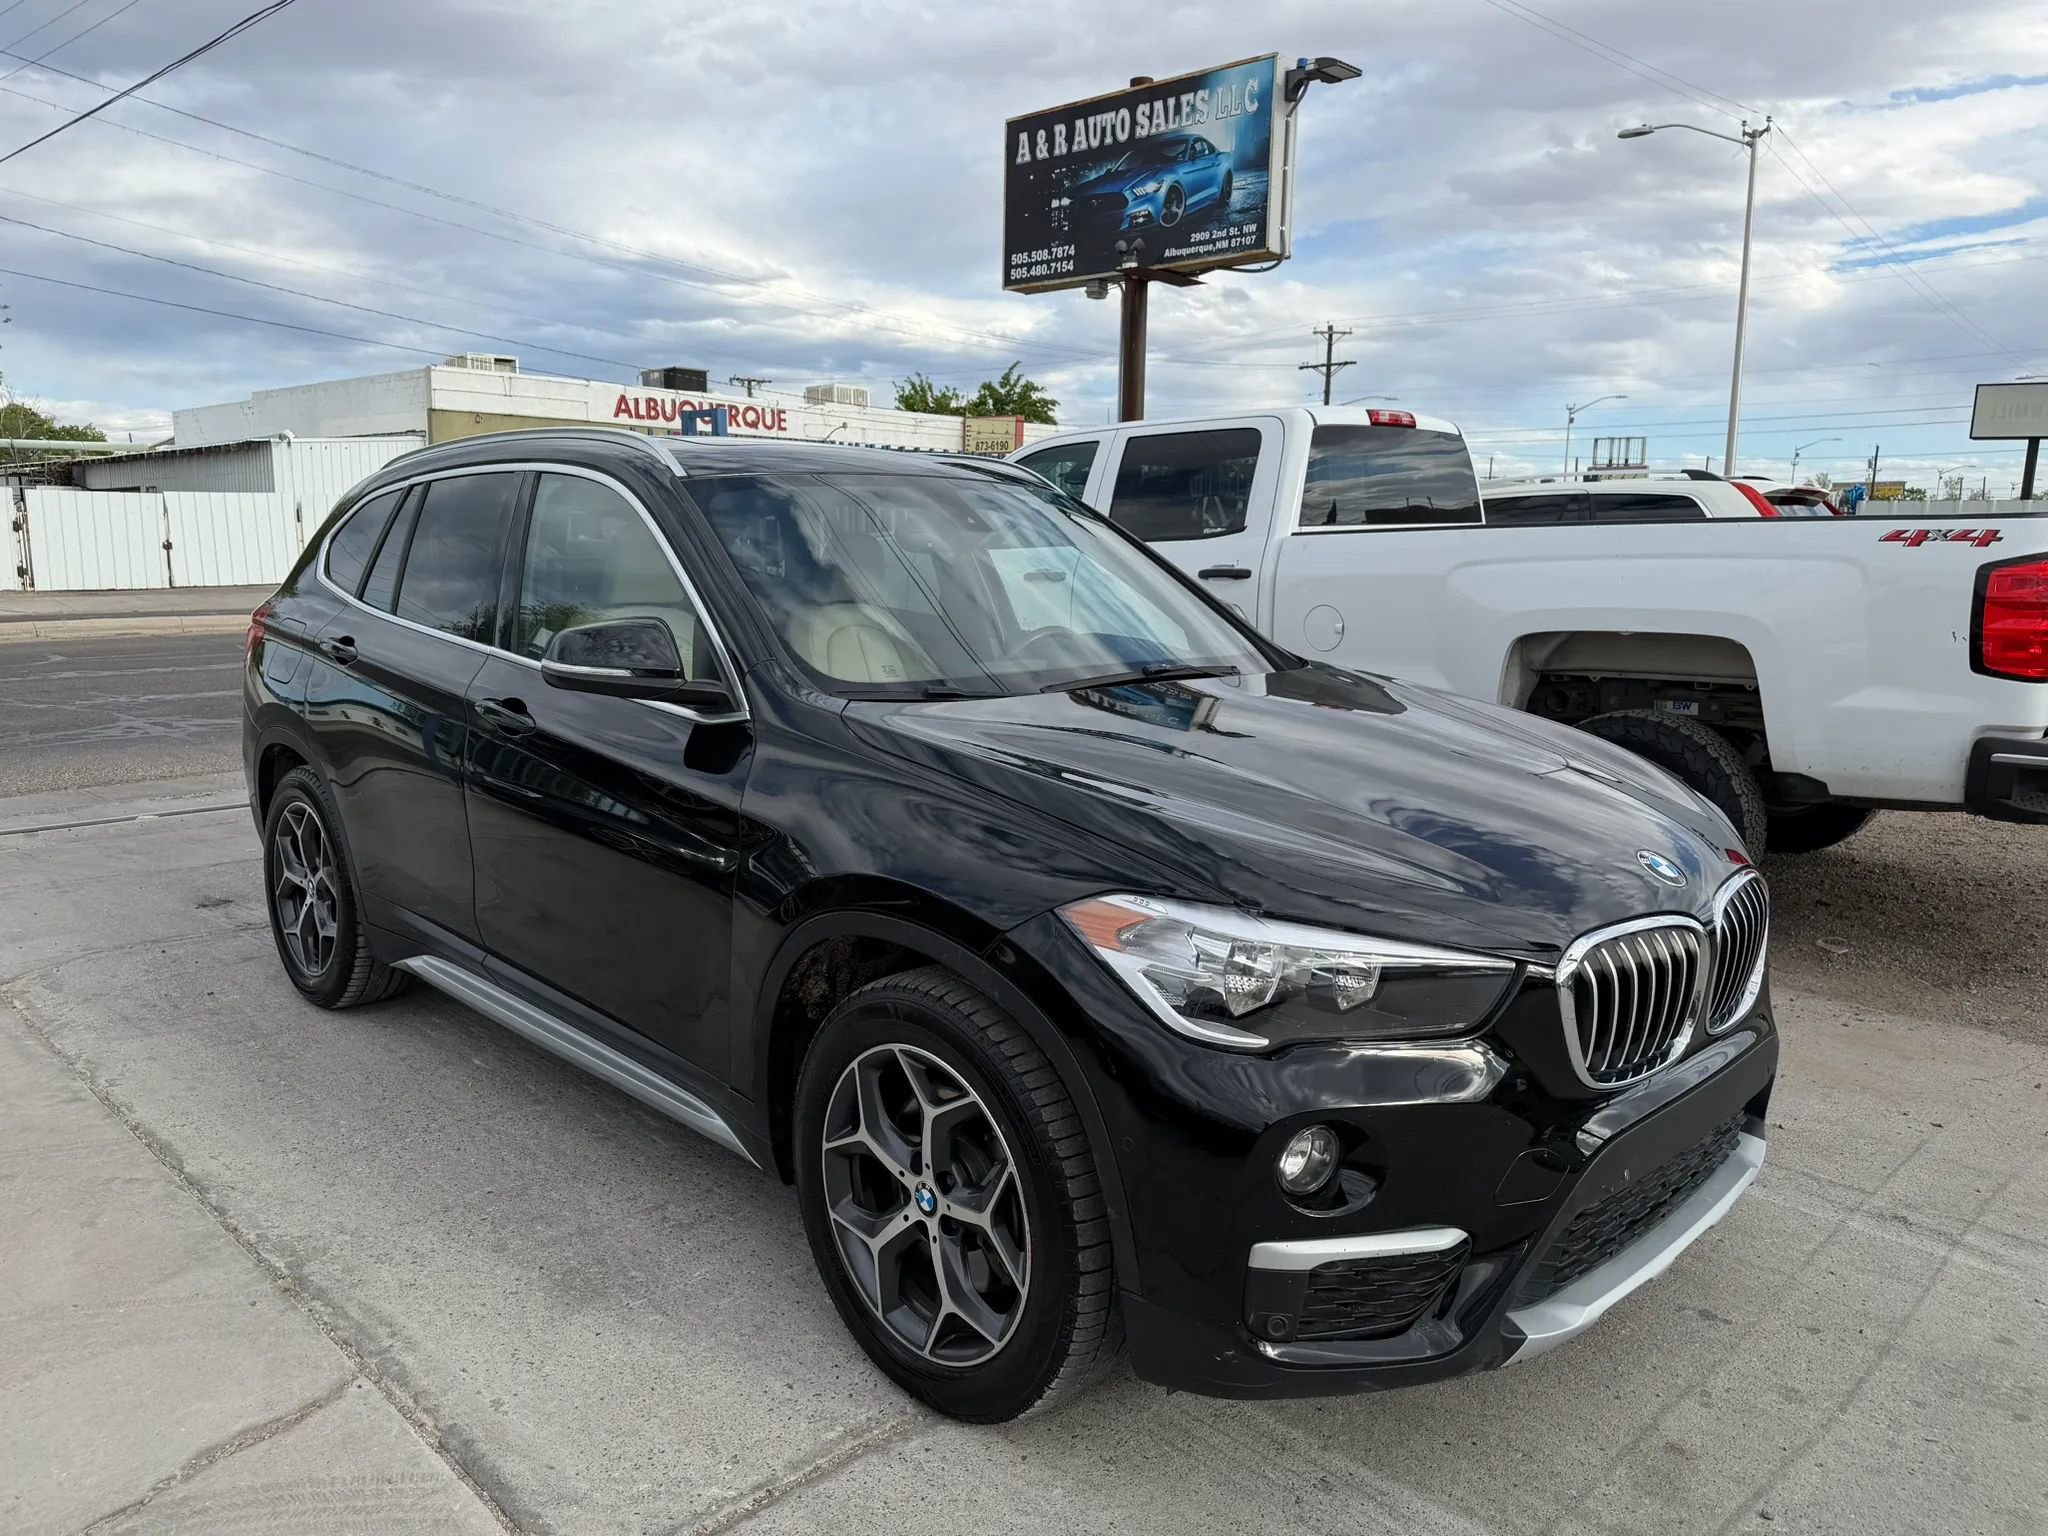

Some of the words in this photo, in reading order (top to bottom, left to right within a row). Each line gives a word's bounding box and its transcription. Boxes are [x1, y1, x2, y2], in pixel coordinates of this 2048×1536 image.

[1016, 132, 1032, 165] A
[1036, 129, 1049, 160] &
[1053, 123, 1068, 157] R
[1072, 107, 1131, 152] AUTO
[1135, 88, 1210, 139] SALES
[1215, 78, 1259, 120] LLC
[1190, 231, 1210, 242] 2909
[1212, 228, 1227, 239] 2nd
[1229, 226, 1240, 236] St.
[1243, 223, 1257, 234] NW
[1231, 235, 1256, 247] 87107
[1011, 244, 1075, 265] 505.508.7874
[1010, 259, 1074, 280] 505.480.7154
[613, 394, 787, 431] ALBUURQUE
[975, 440, 1009, 451] 873-6190
